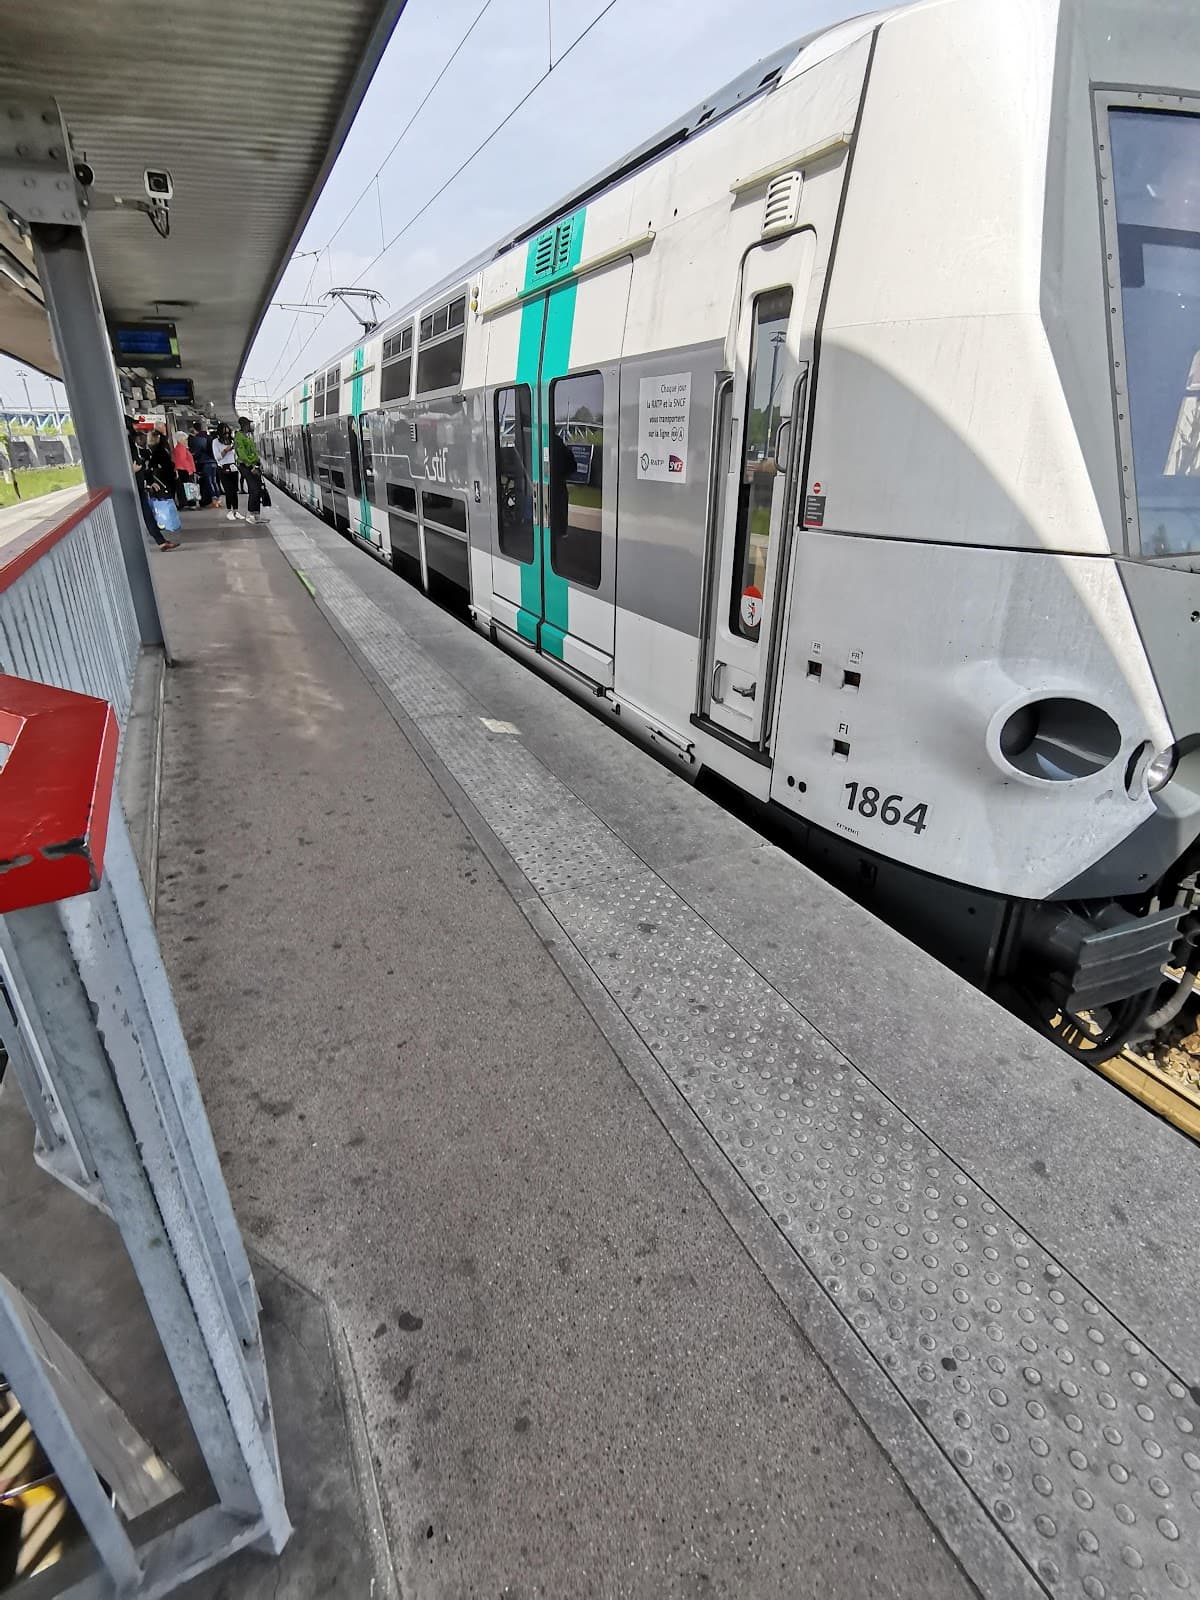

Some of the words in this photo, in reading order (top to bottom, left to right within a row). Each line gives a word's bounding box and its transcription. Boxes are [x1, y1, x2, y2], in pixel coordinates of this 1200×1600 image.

[646, 400, 651, 408] la
[663, 400, 668, 408] et
[673, 397, 686, 408] SNCF
[838, 723, 849, 735] FI
[845, 781, 929, 835] 1864
